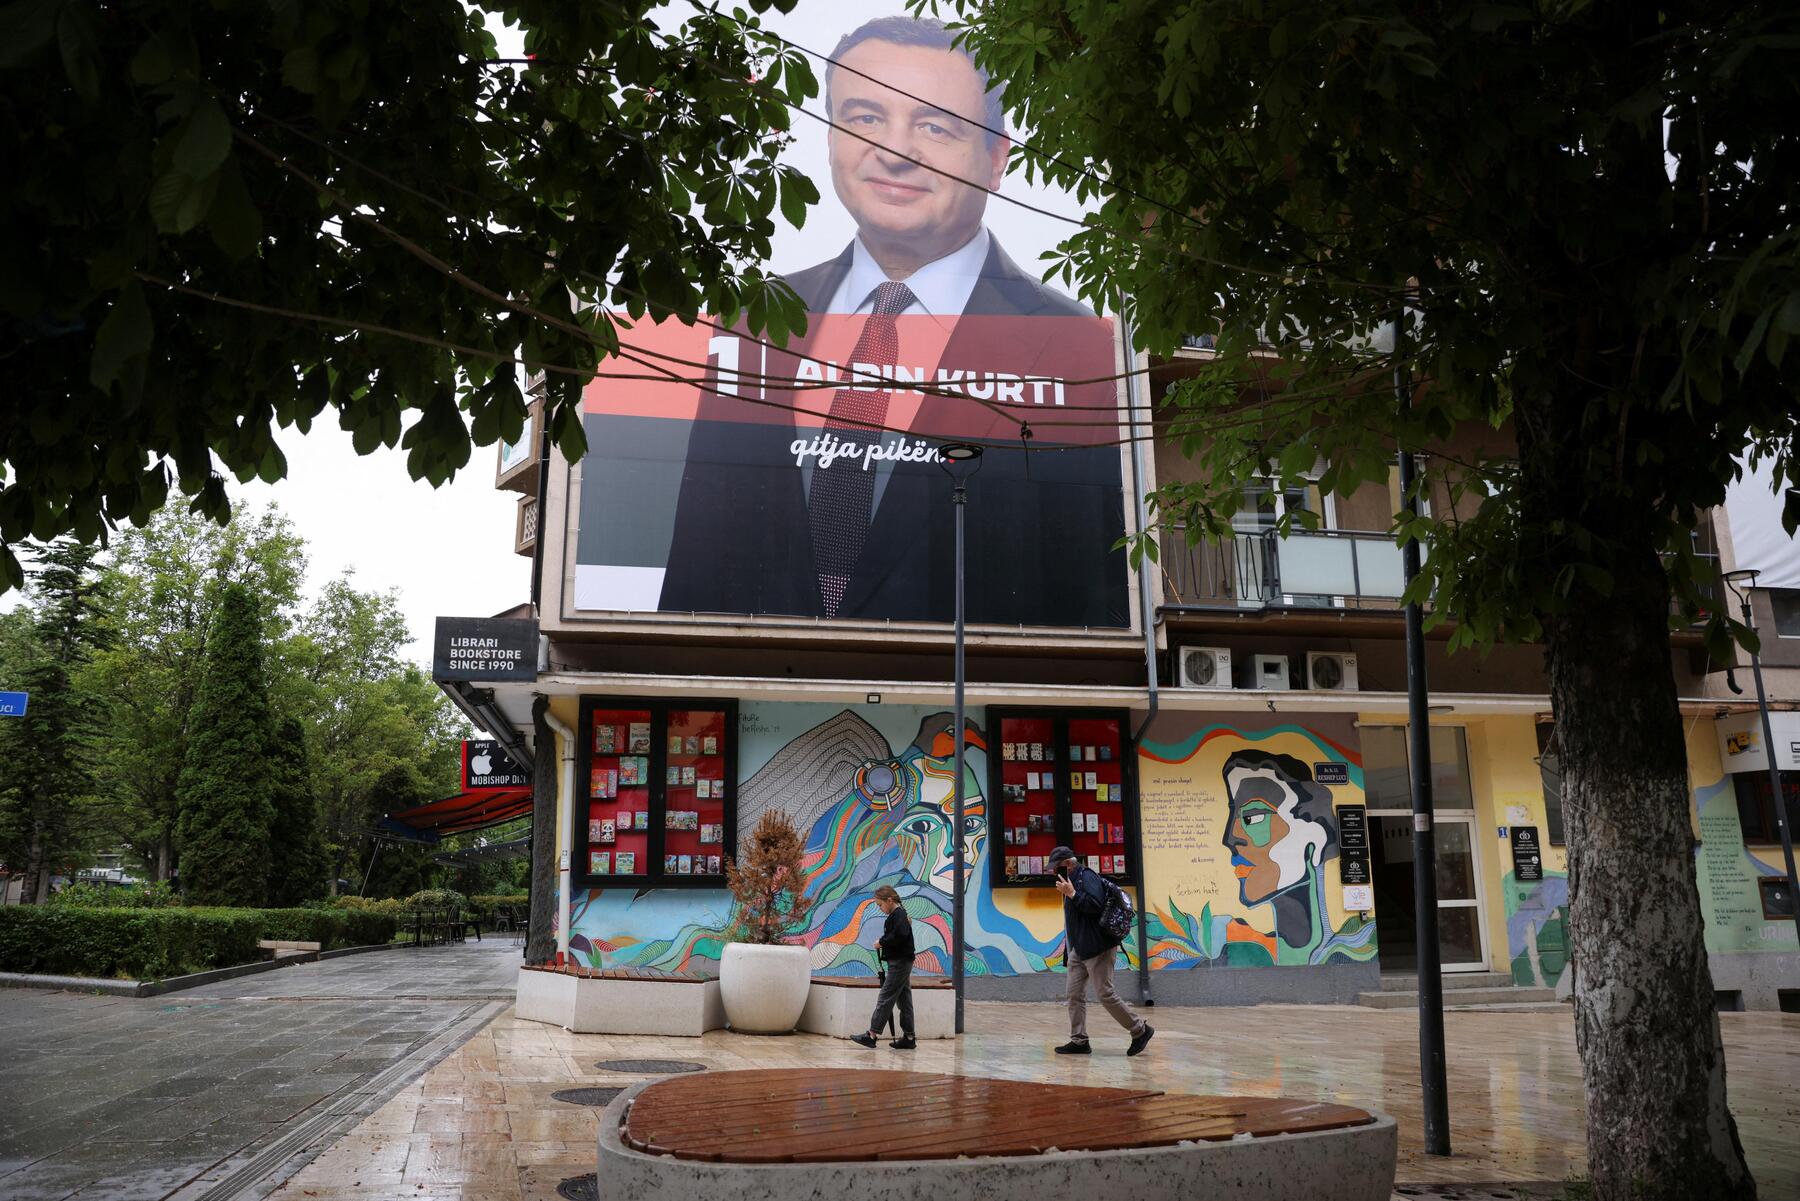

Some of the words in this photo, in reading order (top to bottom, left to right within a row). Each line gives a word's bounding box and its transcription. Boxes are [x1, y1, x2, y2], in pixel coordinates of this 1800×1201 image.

[708, 335, 740, 397] 1
[793, 358, 926, 395] ALBIN
[937, 368, 1065, 406] KURTI
[790, 433, 863, 469] qitja
[450, 637, 499, 648] LIBRARI
[450, 648, 522, 660] BOOKSTORE
[449, 660, 486, 670] SINCE
[488, 661, 515, 671] 1990
[471, 775, 510, 786] MOBISHOP
